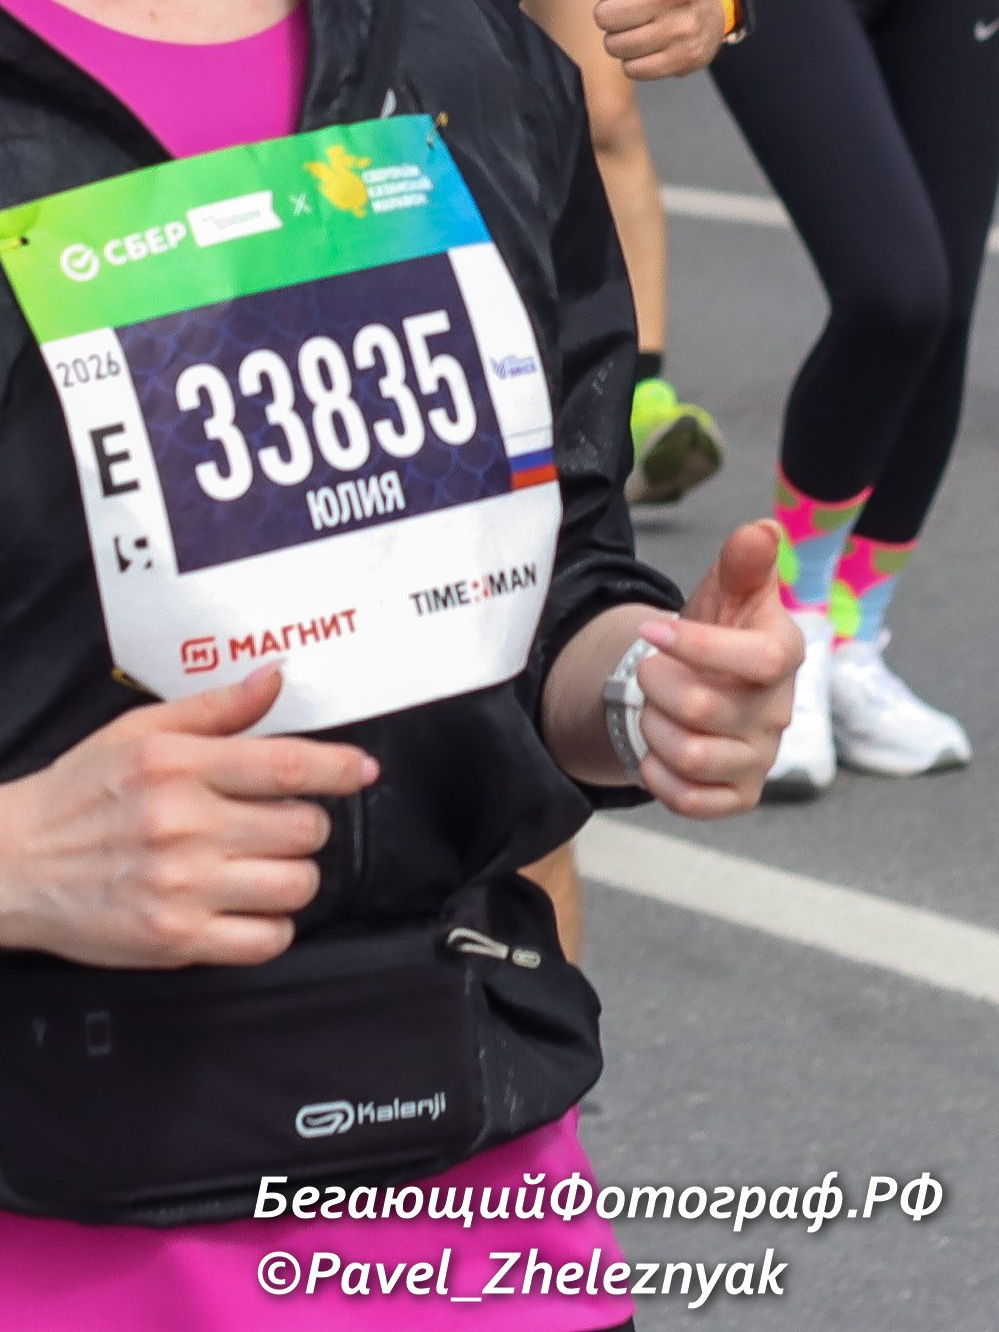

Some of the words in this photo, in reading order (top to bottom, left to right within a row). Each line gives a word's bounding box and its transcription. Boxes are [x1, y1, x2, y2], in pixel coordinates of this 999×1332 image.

[103, 220, 188, 267] СБЕР
[56, 350, 122, 389] 2026
[175, 310, 477, 503] 33835
[306, 471, 407, 531] ЮЛИЯ
[228, 608, 357, 661] МАГНИТ
[357, 1092, 446, 1125] Kalenji
